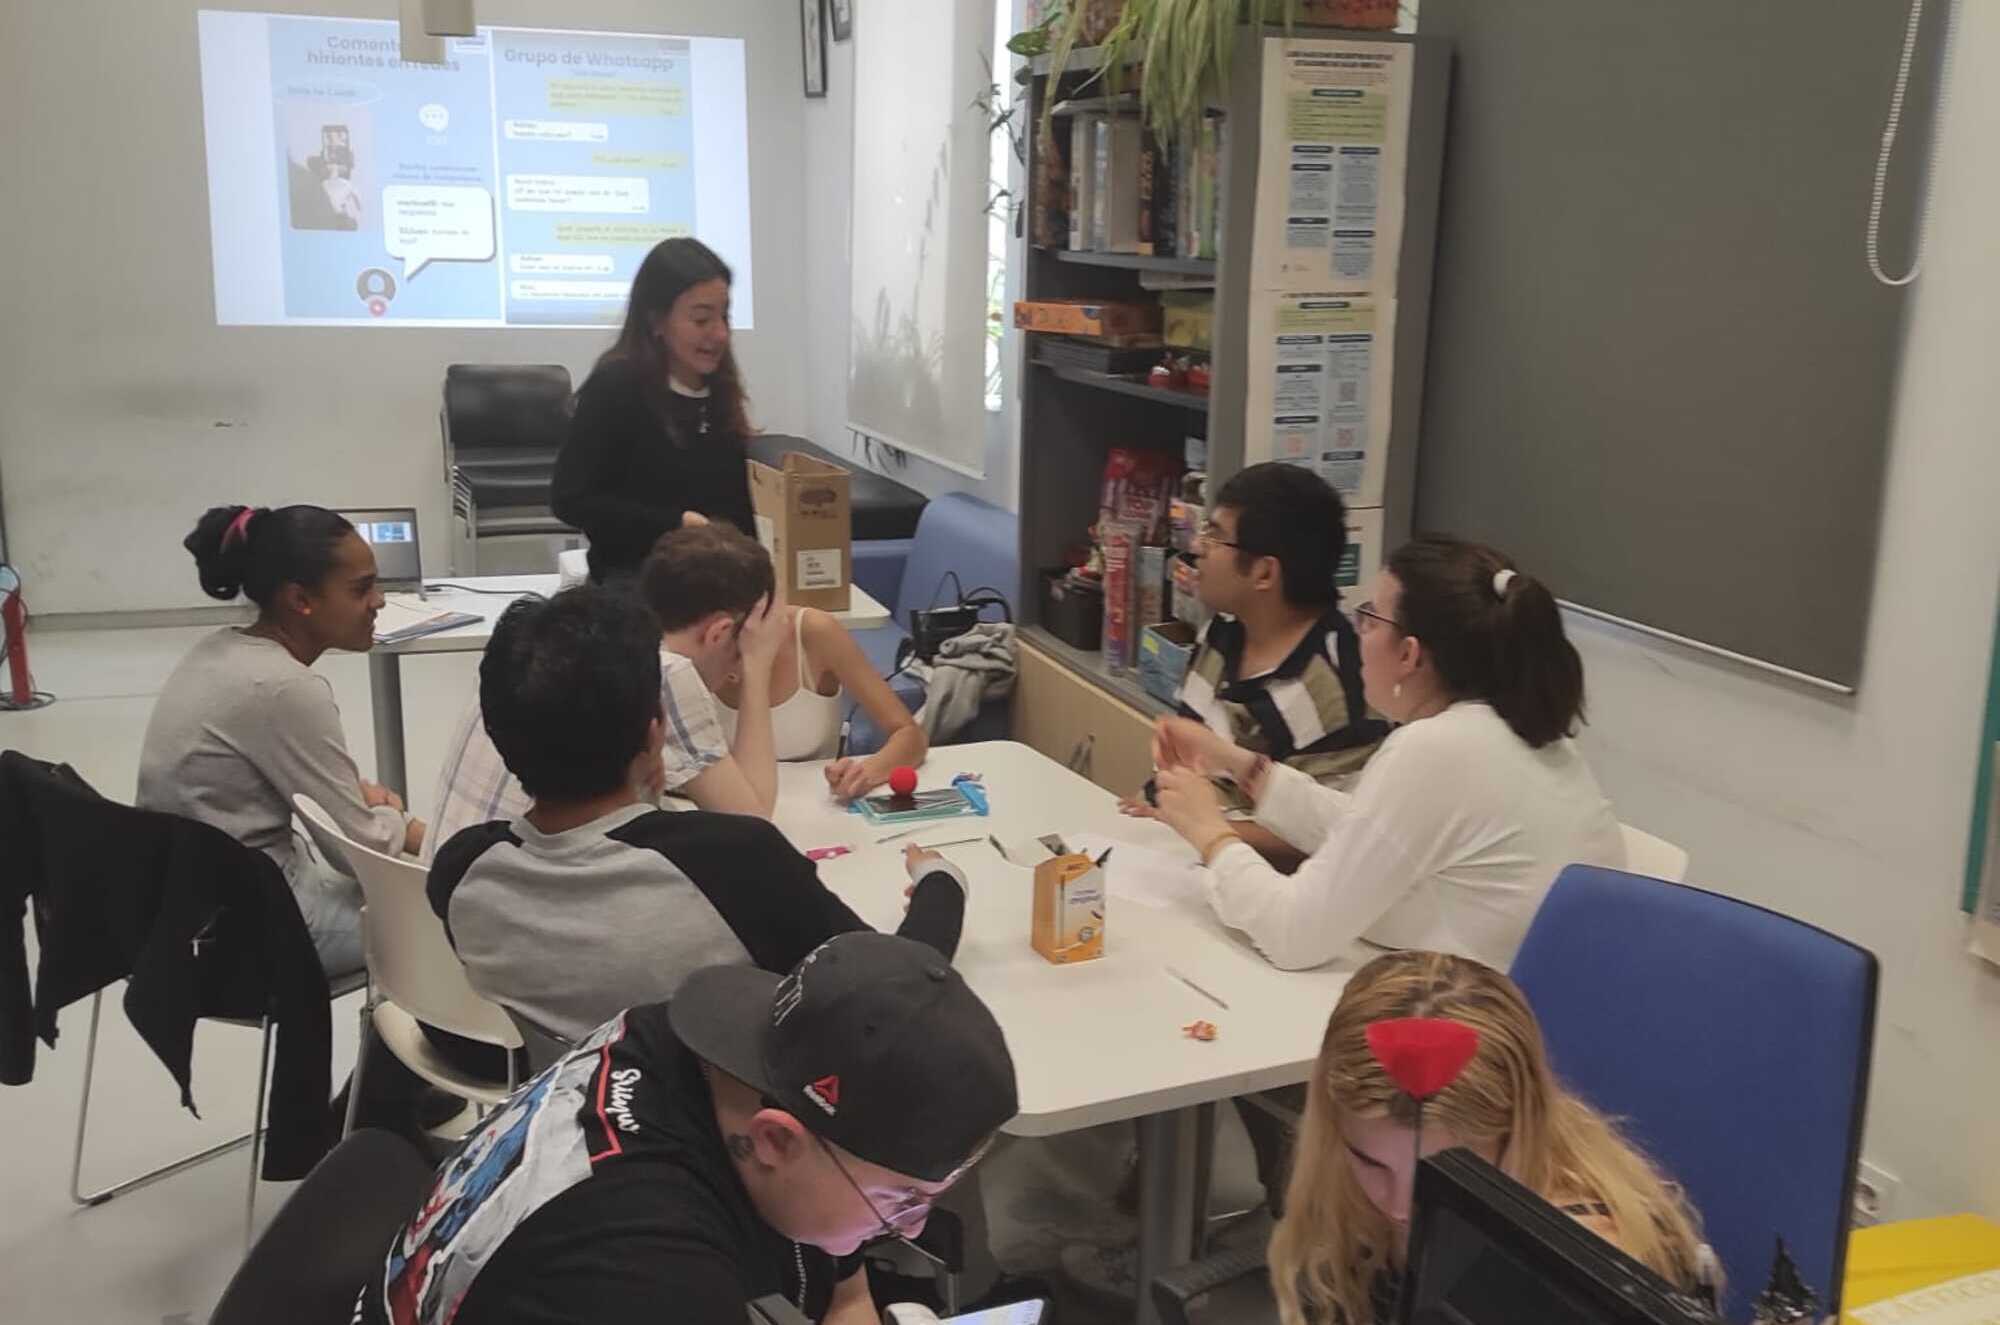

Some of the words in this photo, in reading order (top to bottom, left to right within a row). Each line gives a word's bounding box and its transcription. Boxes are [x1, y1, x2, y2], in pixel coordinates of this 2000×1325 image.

[327, 36, 401, 51] Coment
[504, 49, 557, 67] Grupo
[561, 49, 582, 65] de
[586, 51, 675, 73] Whatsapp
